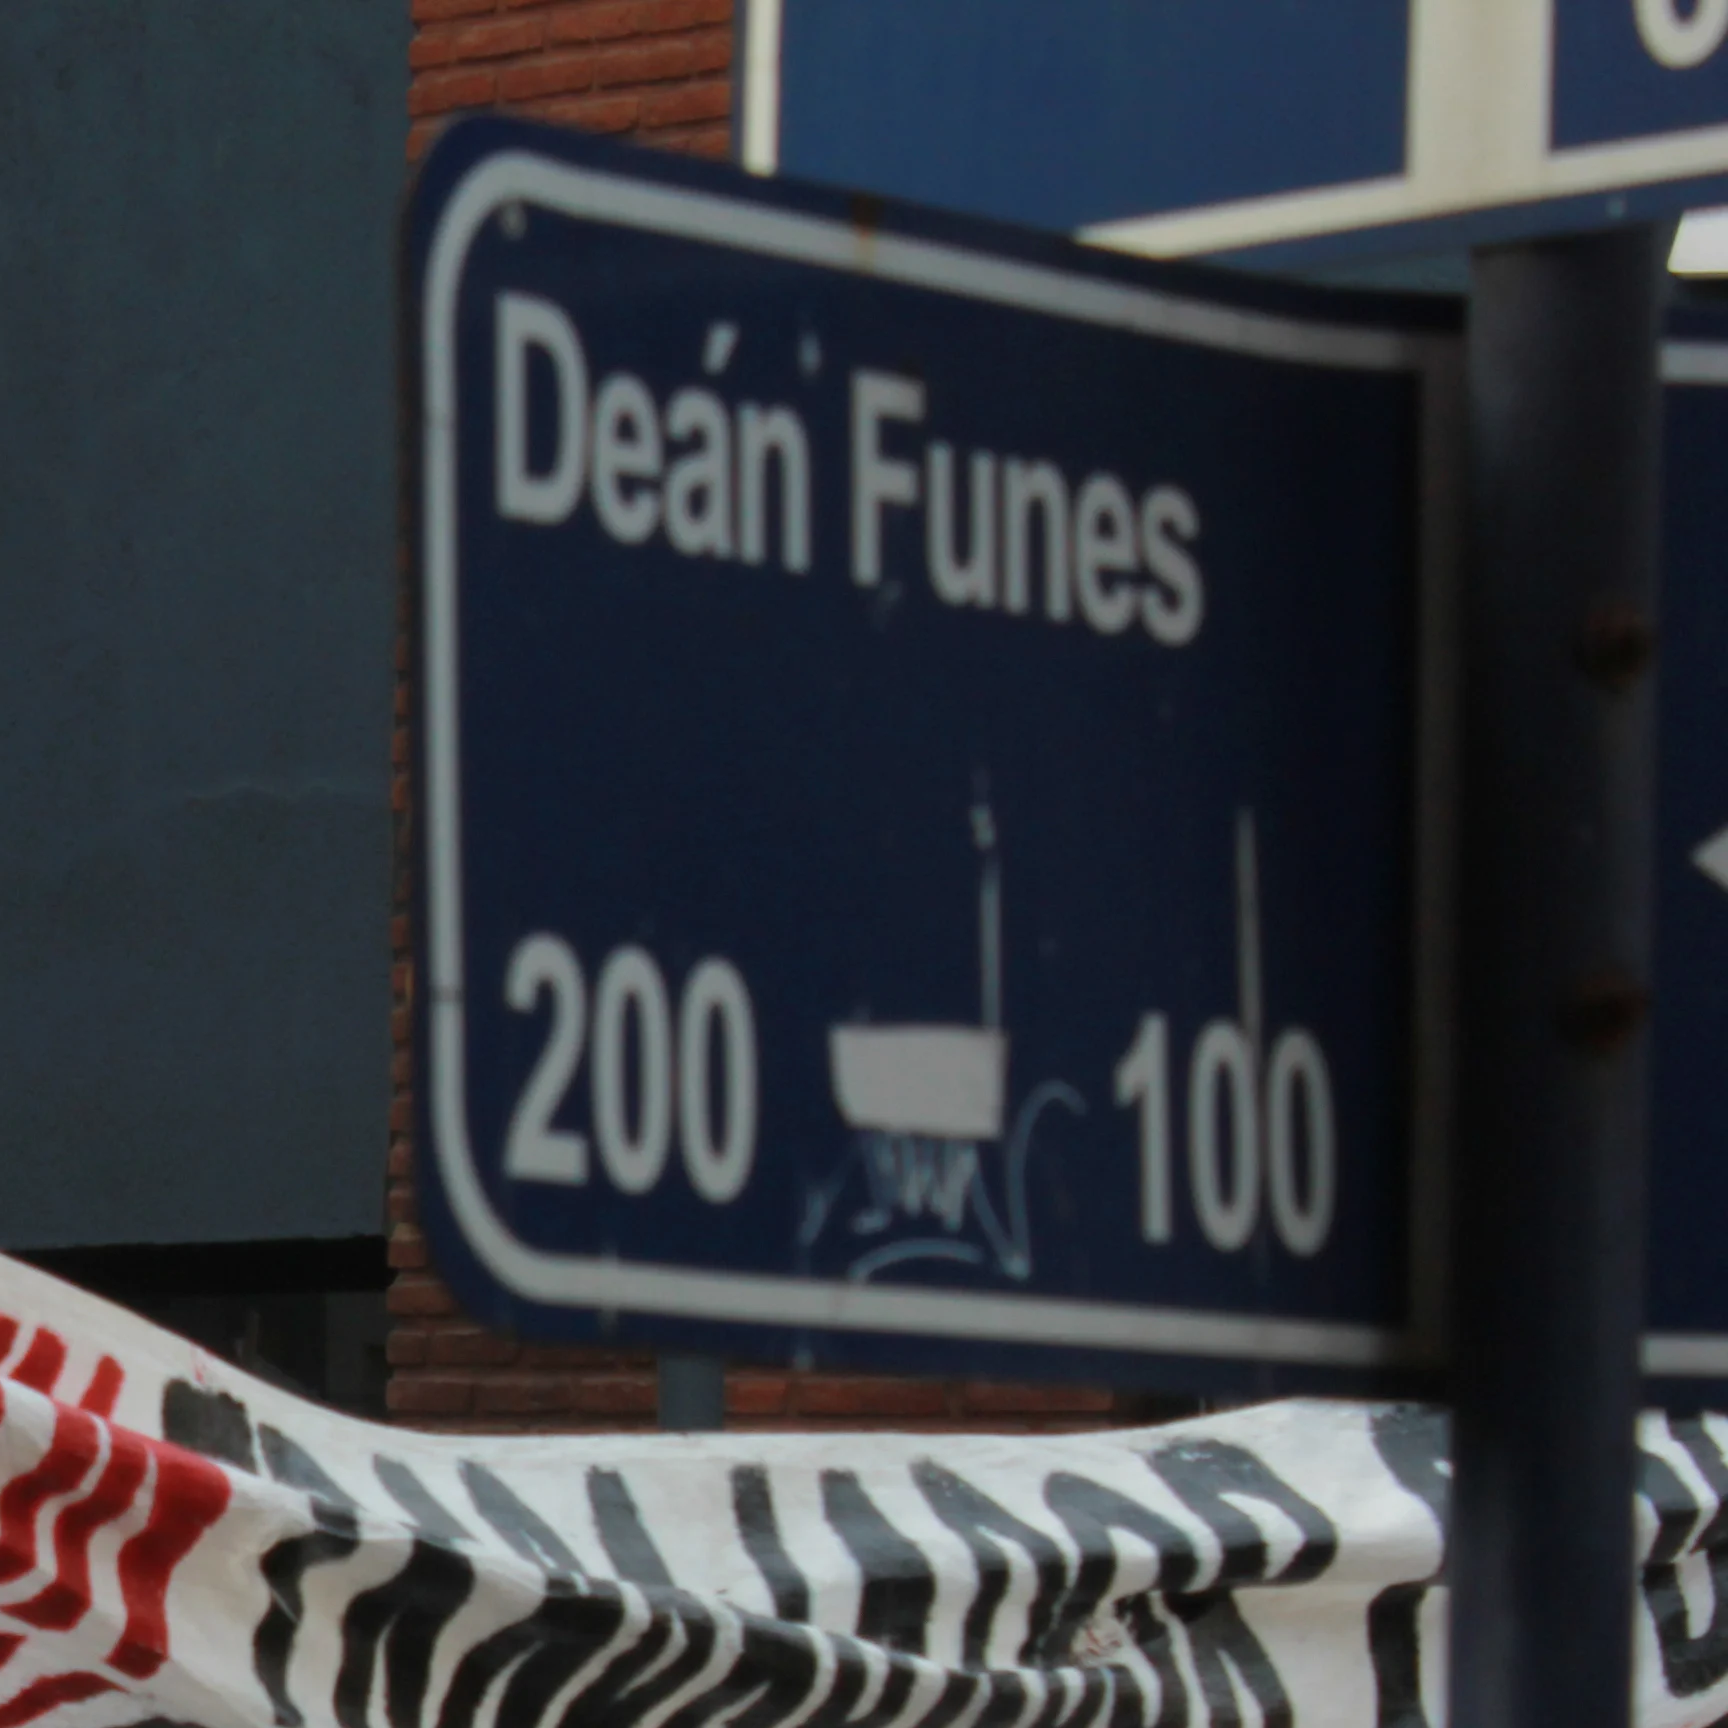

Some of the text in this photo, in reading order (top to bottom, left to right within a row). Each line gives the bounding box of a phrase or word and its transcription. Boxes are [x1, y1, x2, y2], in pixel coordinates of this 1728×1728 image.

[494, 292, 1204, 646] Deán Funes
[501, 932, 758, 1202] 200
[1114, 1011, 1335, 1257] 100
